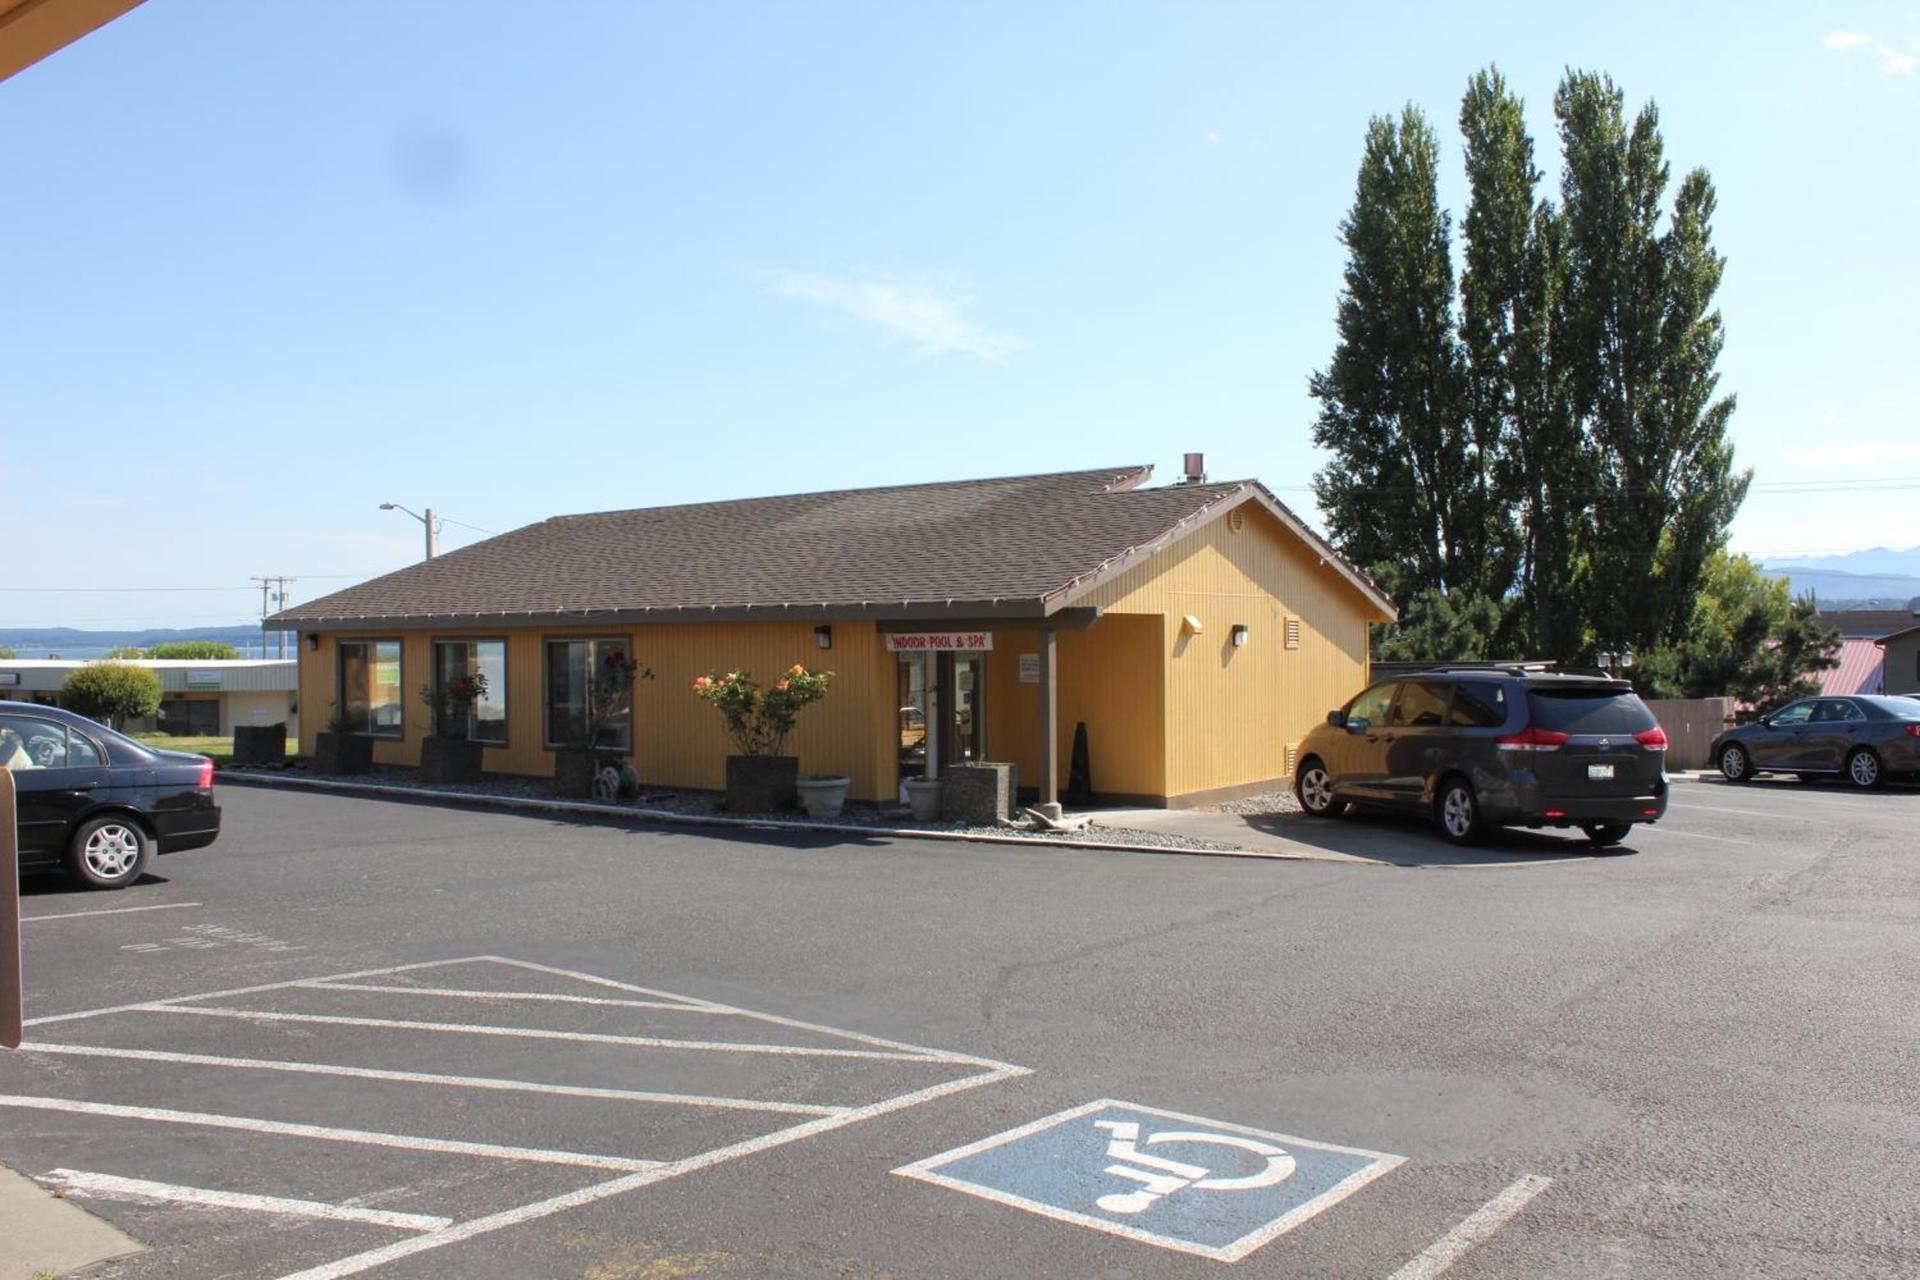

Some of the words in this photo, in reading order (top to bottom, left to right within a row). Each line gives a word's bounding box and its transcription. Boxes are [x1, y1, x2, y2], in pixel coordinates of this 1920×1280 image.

[929, 635, 953, 648] POOL
[956, 635, 964, 648] &
[968, 634, 986, 648] SPA
